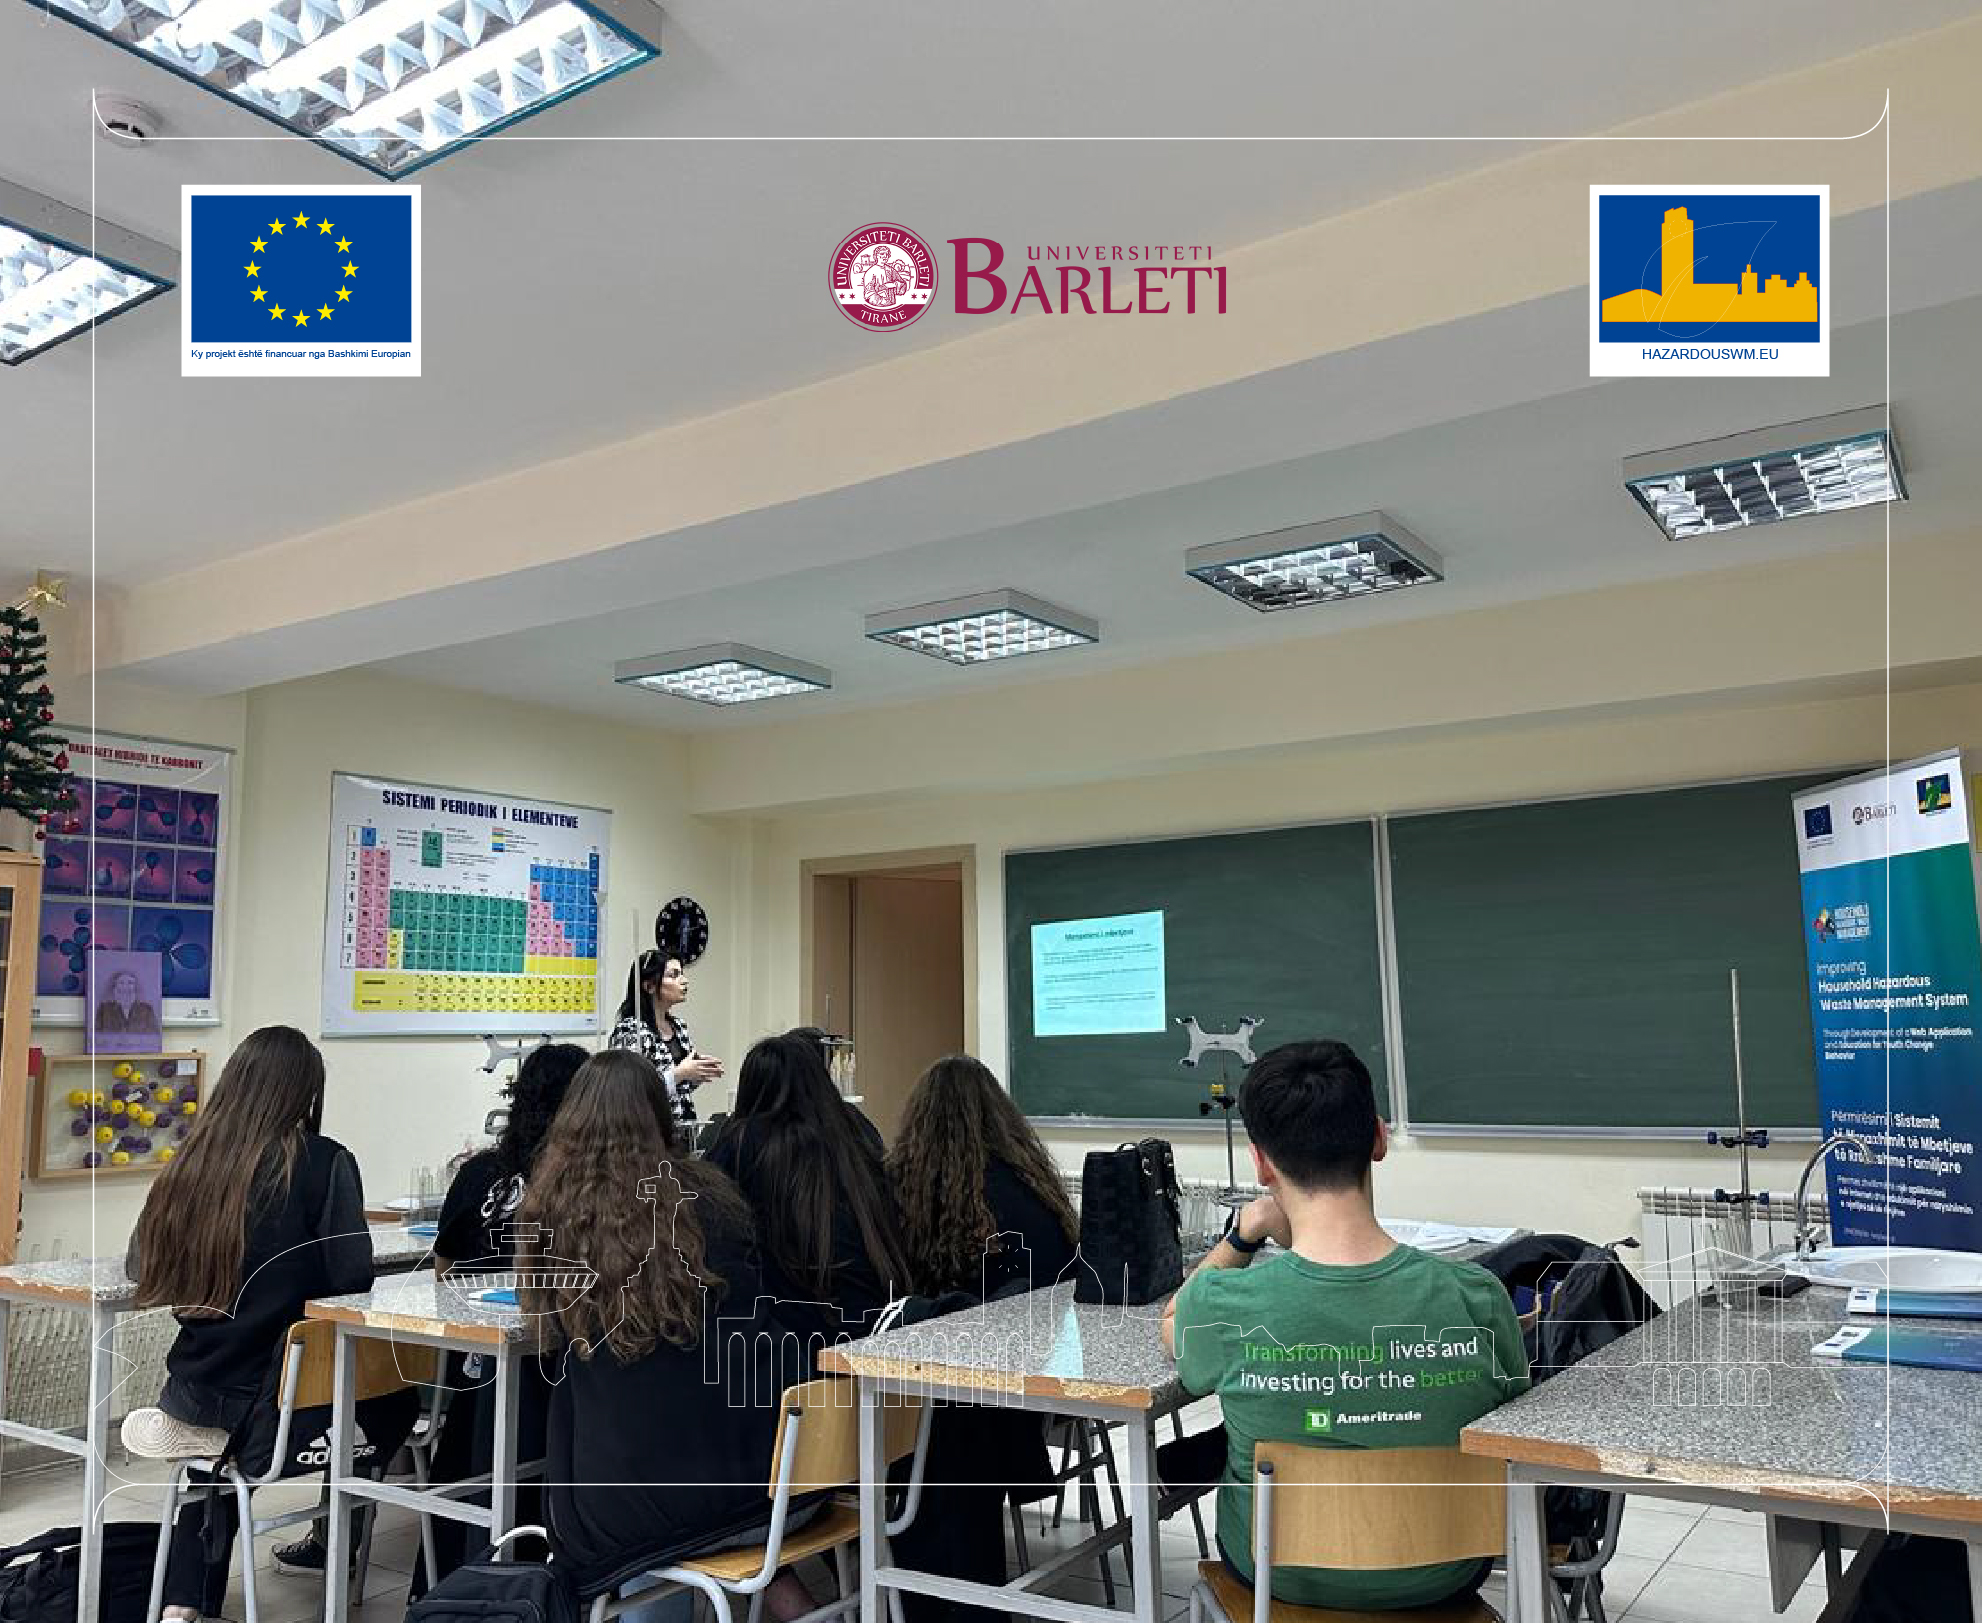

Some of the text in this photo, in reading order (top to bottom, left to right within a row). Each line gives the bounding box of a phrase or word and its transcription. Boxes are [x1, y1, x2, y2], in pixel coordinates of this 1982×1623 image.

[382, 790, 579, 829] SISTEMI PERIODIK I ELEMENTEVE
[1816, 961, 1867, 977] Improving
[1818, 974, 1931, 993] Household Hazardous
[1820, 993, 1969, 1012] Waste Management System
[1894, 1111, 1941, 1129] Sistemit
[1920, 1136, 1974, 1157] Mbetjeve
[1907, 1154, 1962, 1177] Familjare
[1244, 1336, 1478, 1364] Transforming lives and
[1240, 1368, 1483, 1396] investing for the better
[1336, 1410, 1422, 1425] Ameritrade
